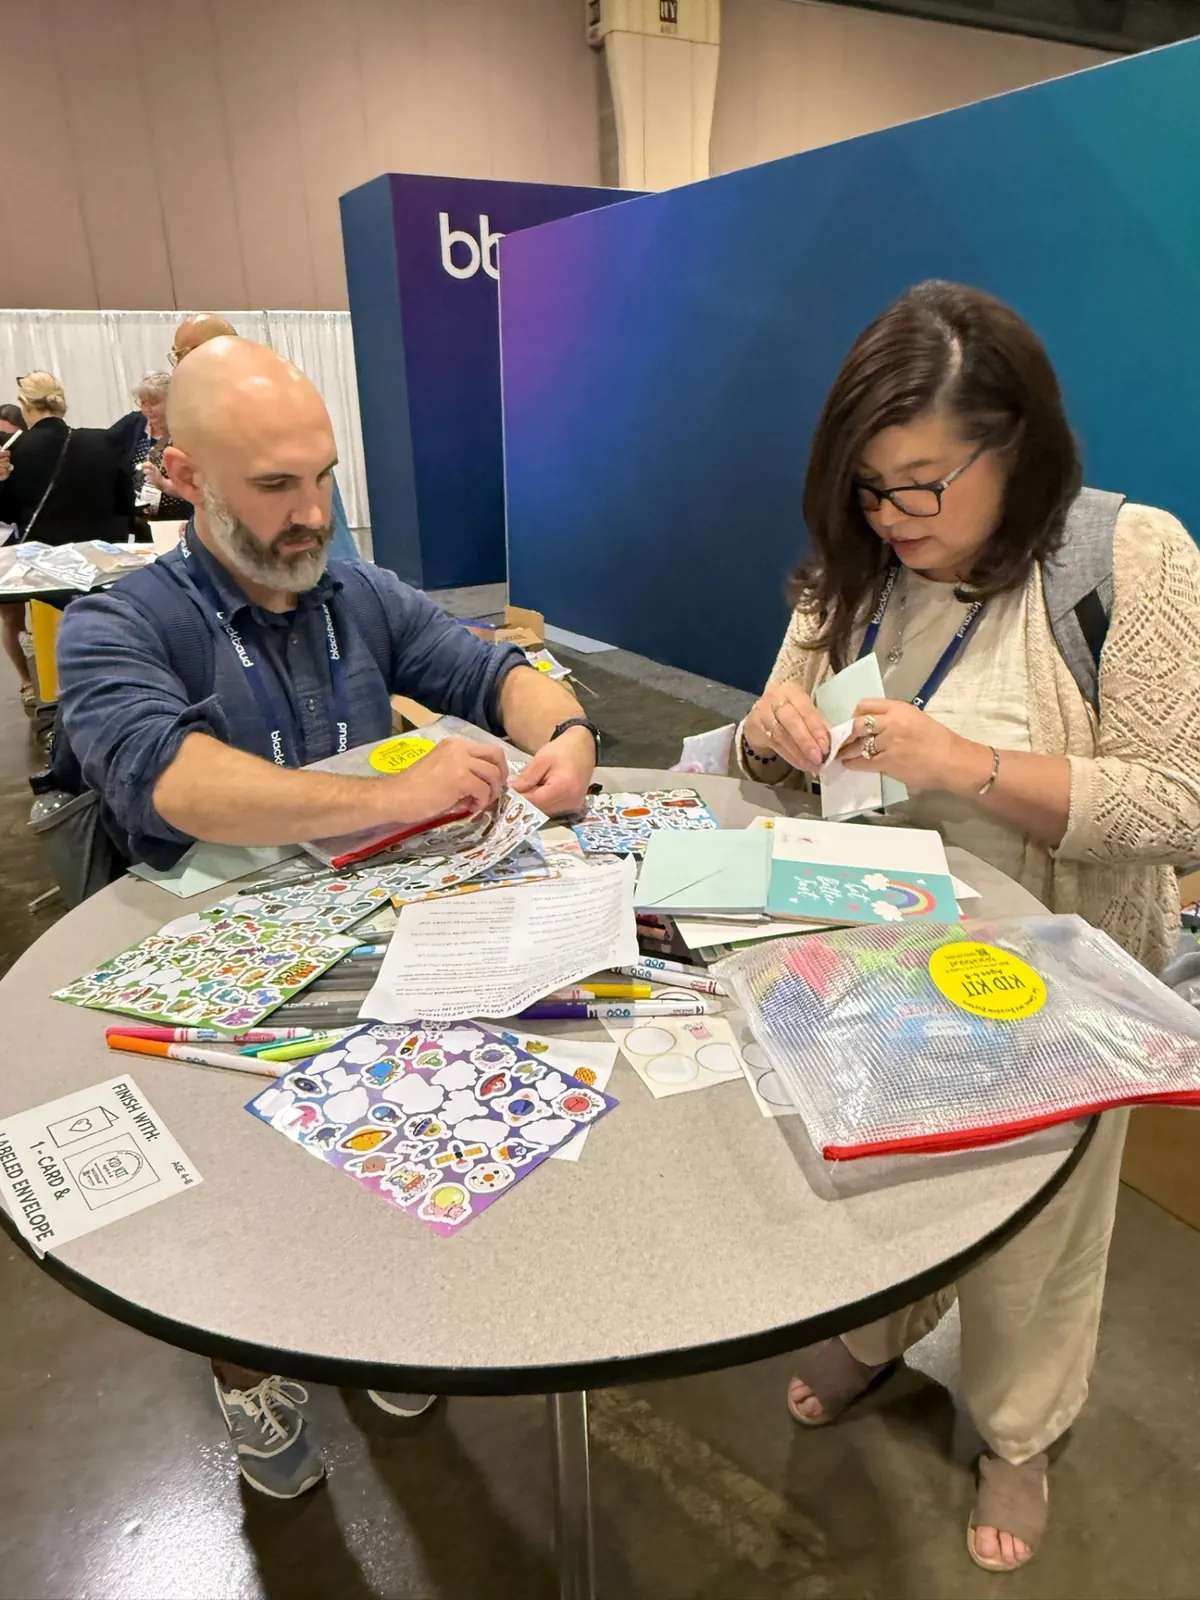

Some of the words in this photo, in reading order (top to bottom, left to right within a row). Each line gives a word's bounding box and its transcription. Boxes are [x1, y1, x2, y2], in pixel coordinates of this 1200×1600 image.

[961, 978, 994, 997] KIT
[992, 973, 1027, 991] KID
[111, 1082, 142, 1114] FINISH
[132, 1112, 161, 1142] WITH:
[29, 1140, 46, 1150] 1
[37, 1156, 66, 1187] CARD
[54, 1187, 71, 1201] &
[12, 1178, 55, 1242] ENVELOPE
